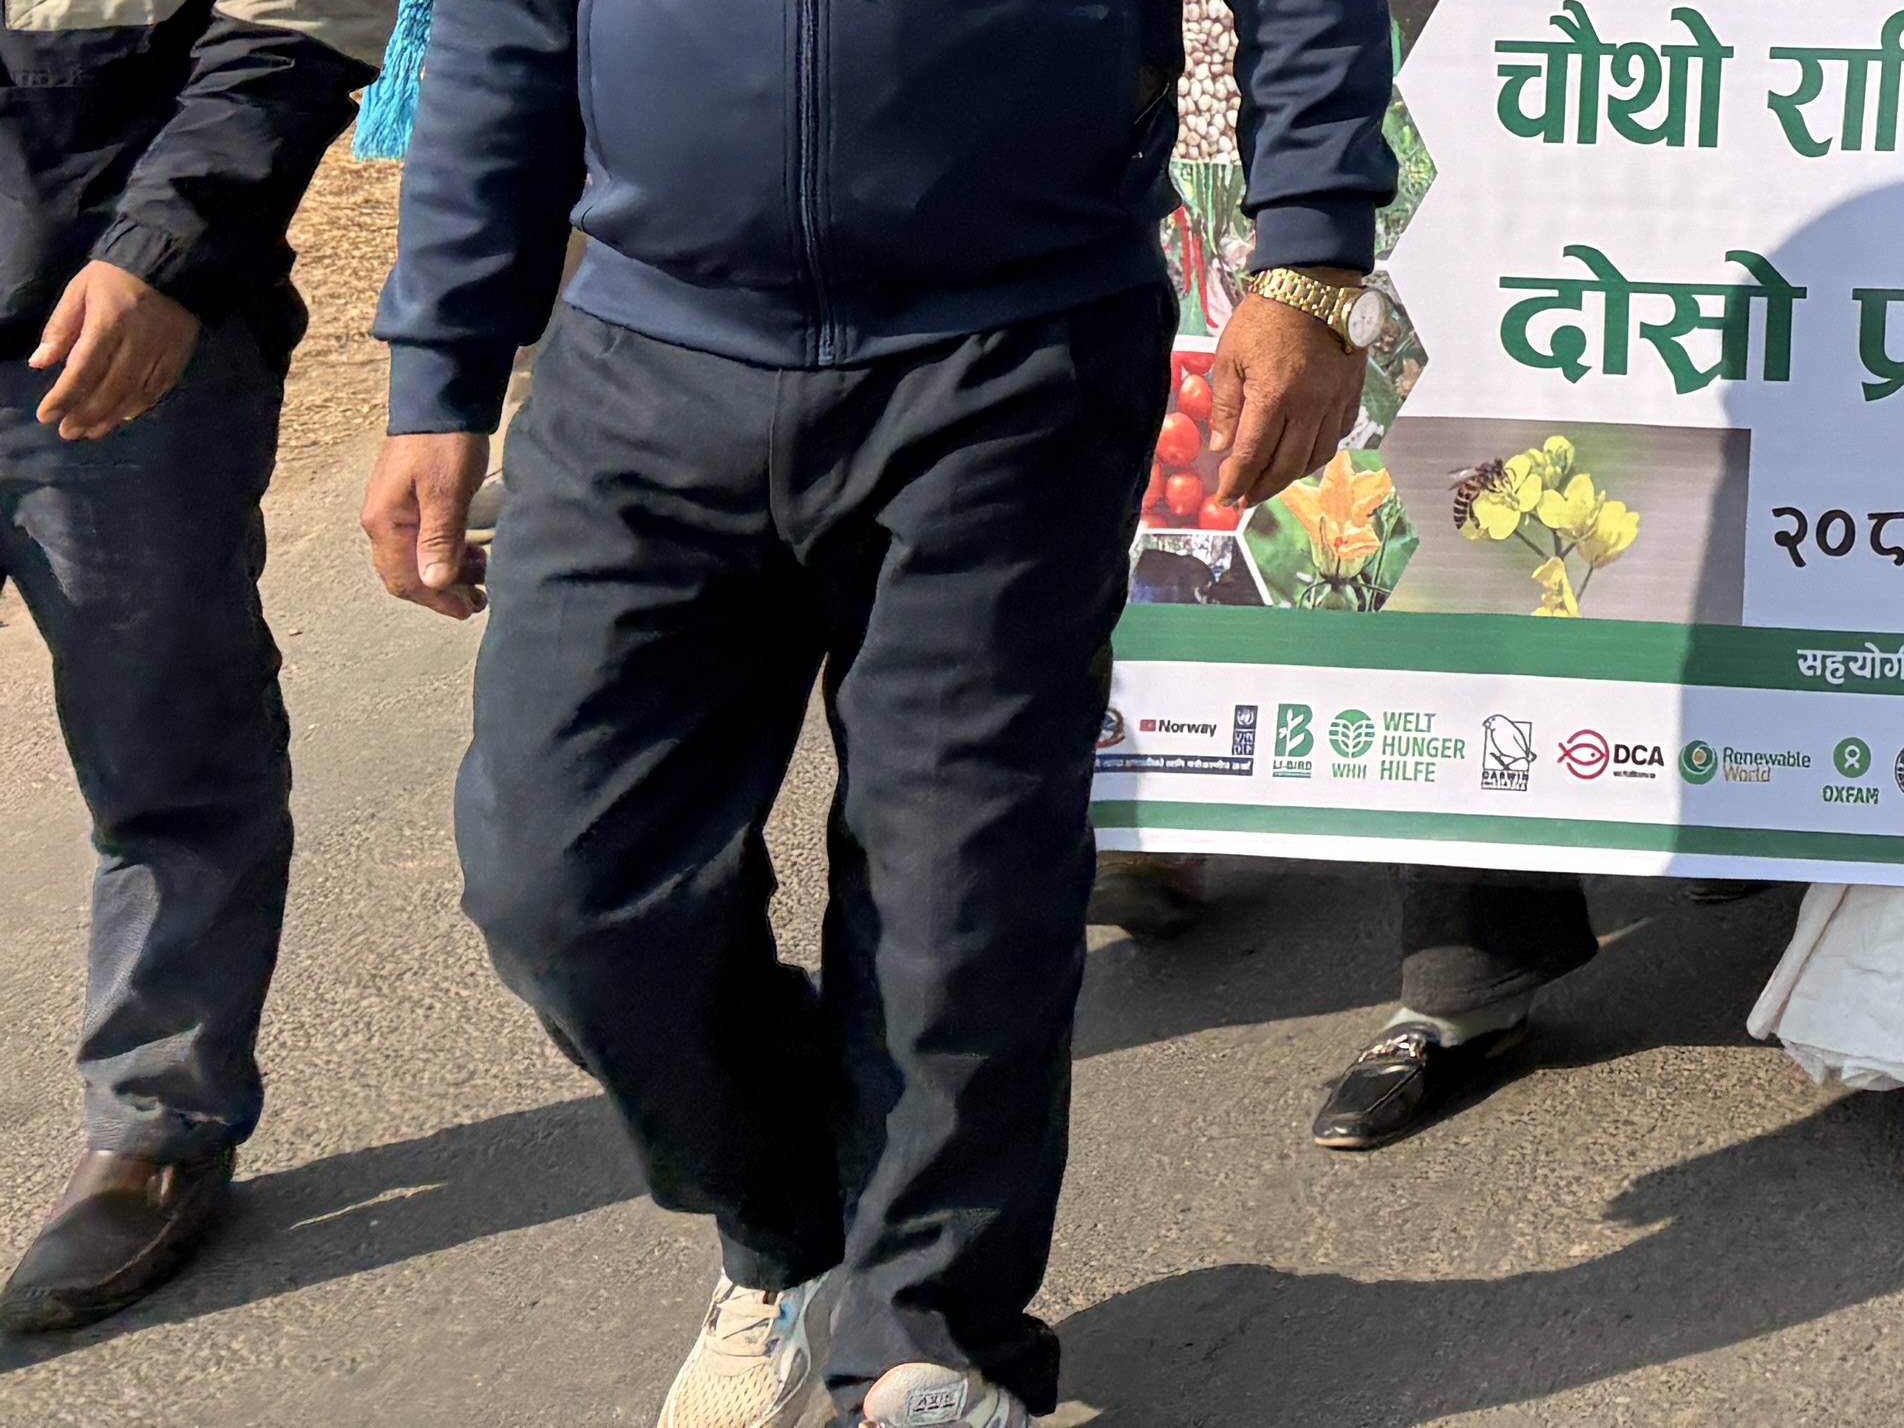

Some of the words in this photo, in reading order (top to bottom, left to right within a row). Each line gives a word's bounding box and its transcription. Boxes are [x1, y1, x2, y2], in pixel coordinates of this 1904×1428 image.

[1494, 0, 1735, 149] चौथो
[1499, 244, 1808, 395] दोस्रो
[1158, 719, 1217, 738] Norway
[1382, 711, 1437, 733] WELT
[1381, 734, 1466, 760] HUNGER
[1613, 743, 1665, 767] DCA
[1722, 746, 1812, 770] Renewable
[1331, 762, 1367, 780] WHH
[1379, 759, 1437, 783] HILFE
[1722, 764, 1771, 783] World
[1822, 784, 1880, 805] OXFAM
